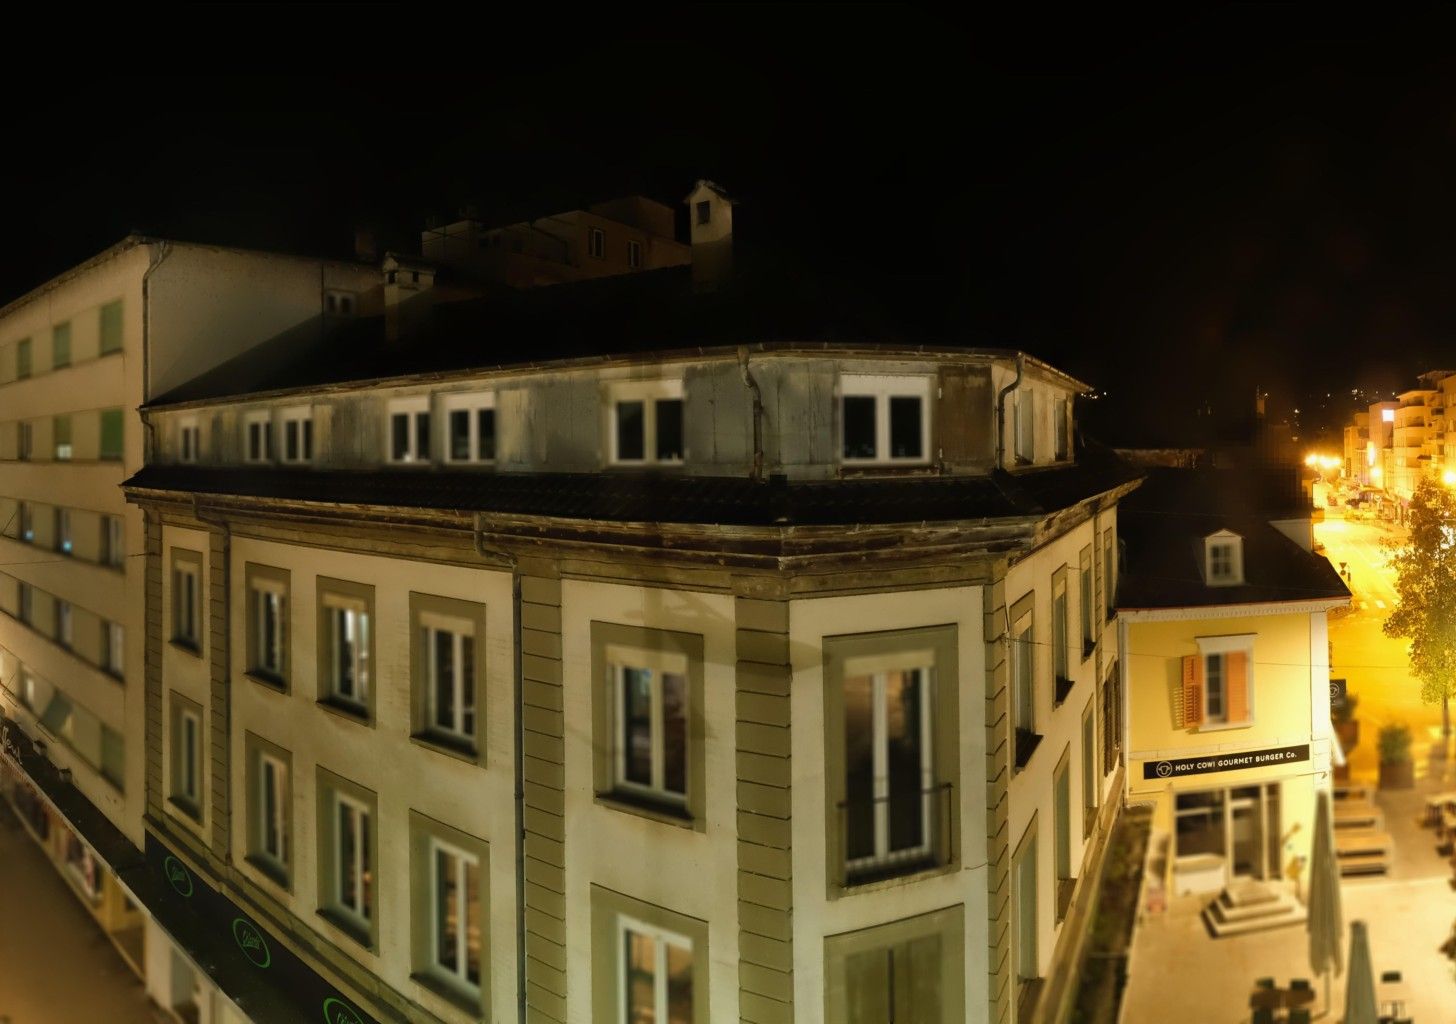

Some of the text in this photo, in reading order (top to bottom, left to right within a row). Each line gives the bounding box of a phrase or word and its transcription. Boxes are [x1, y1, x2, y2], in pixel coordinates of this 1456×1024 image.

[1175, 763, 1194, 771] HOLY
[1218, 757, 1252, 766] GOURMET
[1256, 753, 1283, 762] BURGER
